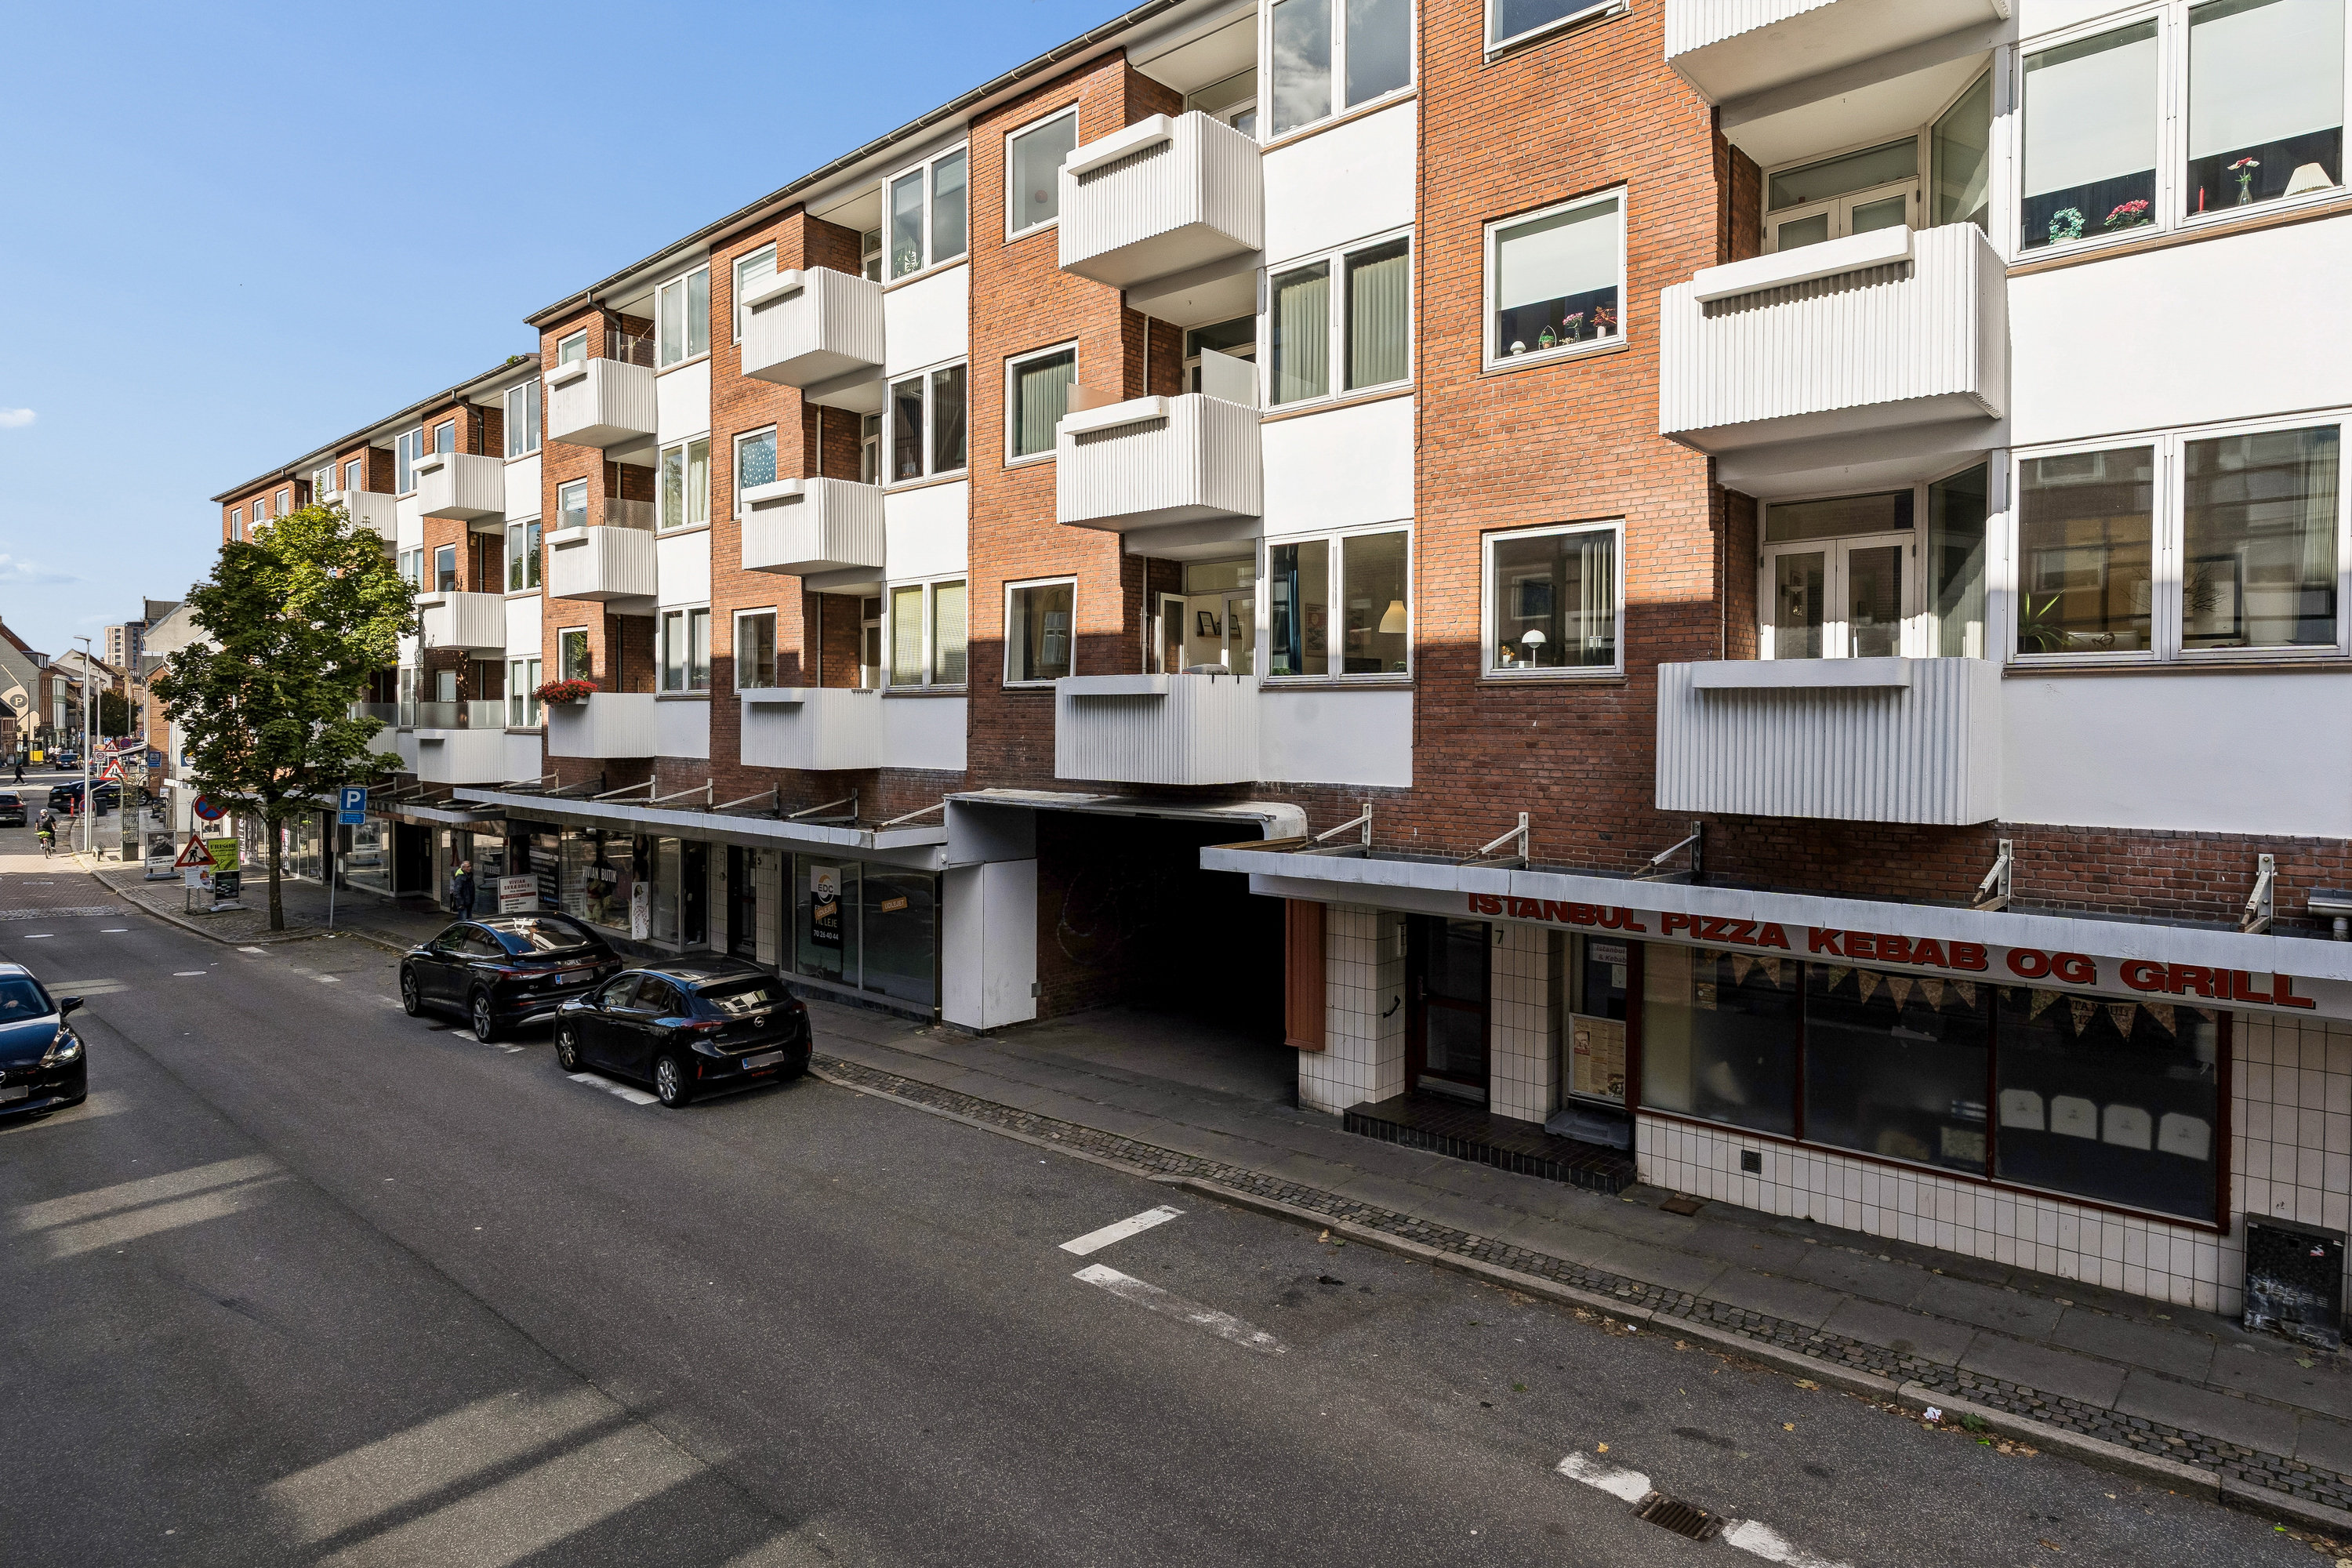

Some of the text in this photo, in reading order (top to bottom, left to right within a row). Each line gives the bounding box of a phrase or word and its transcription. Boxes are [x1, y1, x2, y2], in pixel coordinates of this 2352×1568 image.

[16, 697, 23, 706] P
[347, 790, 361, 808] P
[757, 857, 762, 866] 5
[582, 865, 617, 883] VIVIAN BUTIK
[818, 884, 833, 894] EDC
[884, 899, 904, 909] UDLEJET
[816, 903, 834, 917] UDLEJET
[824, 917, 837, 928] LEJE
[1495, 930, 1504, 944] 7
[1468, 892, 2316, 1010] ISTANBUL PIZZA KEBAB OG GRILL
[1596, 946, 1625, 954] Istanbul
